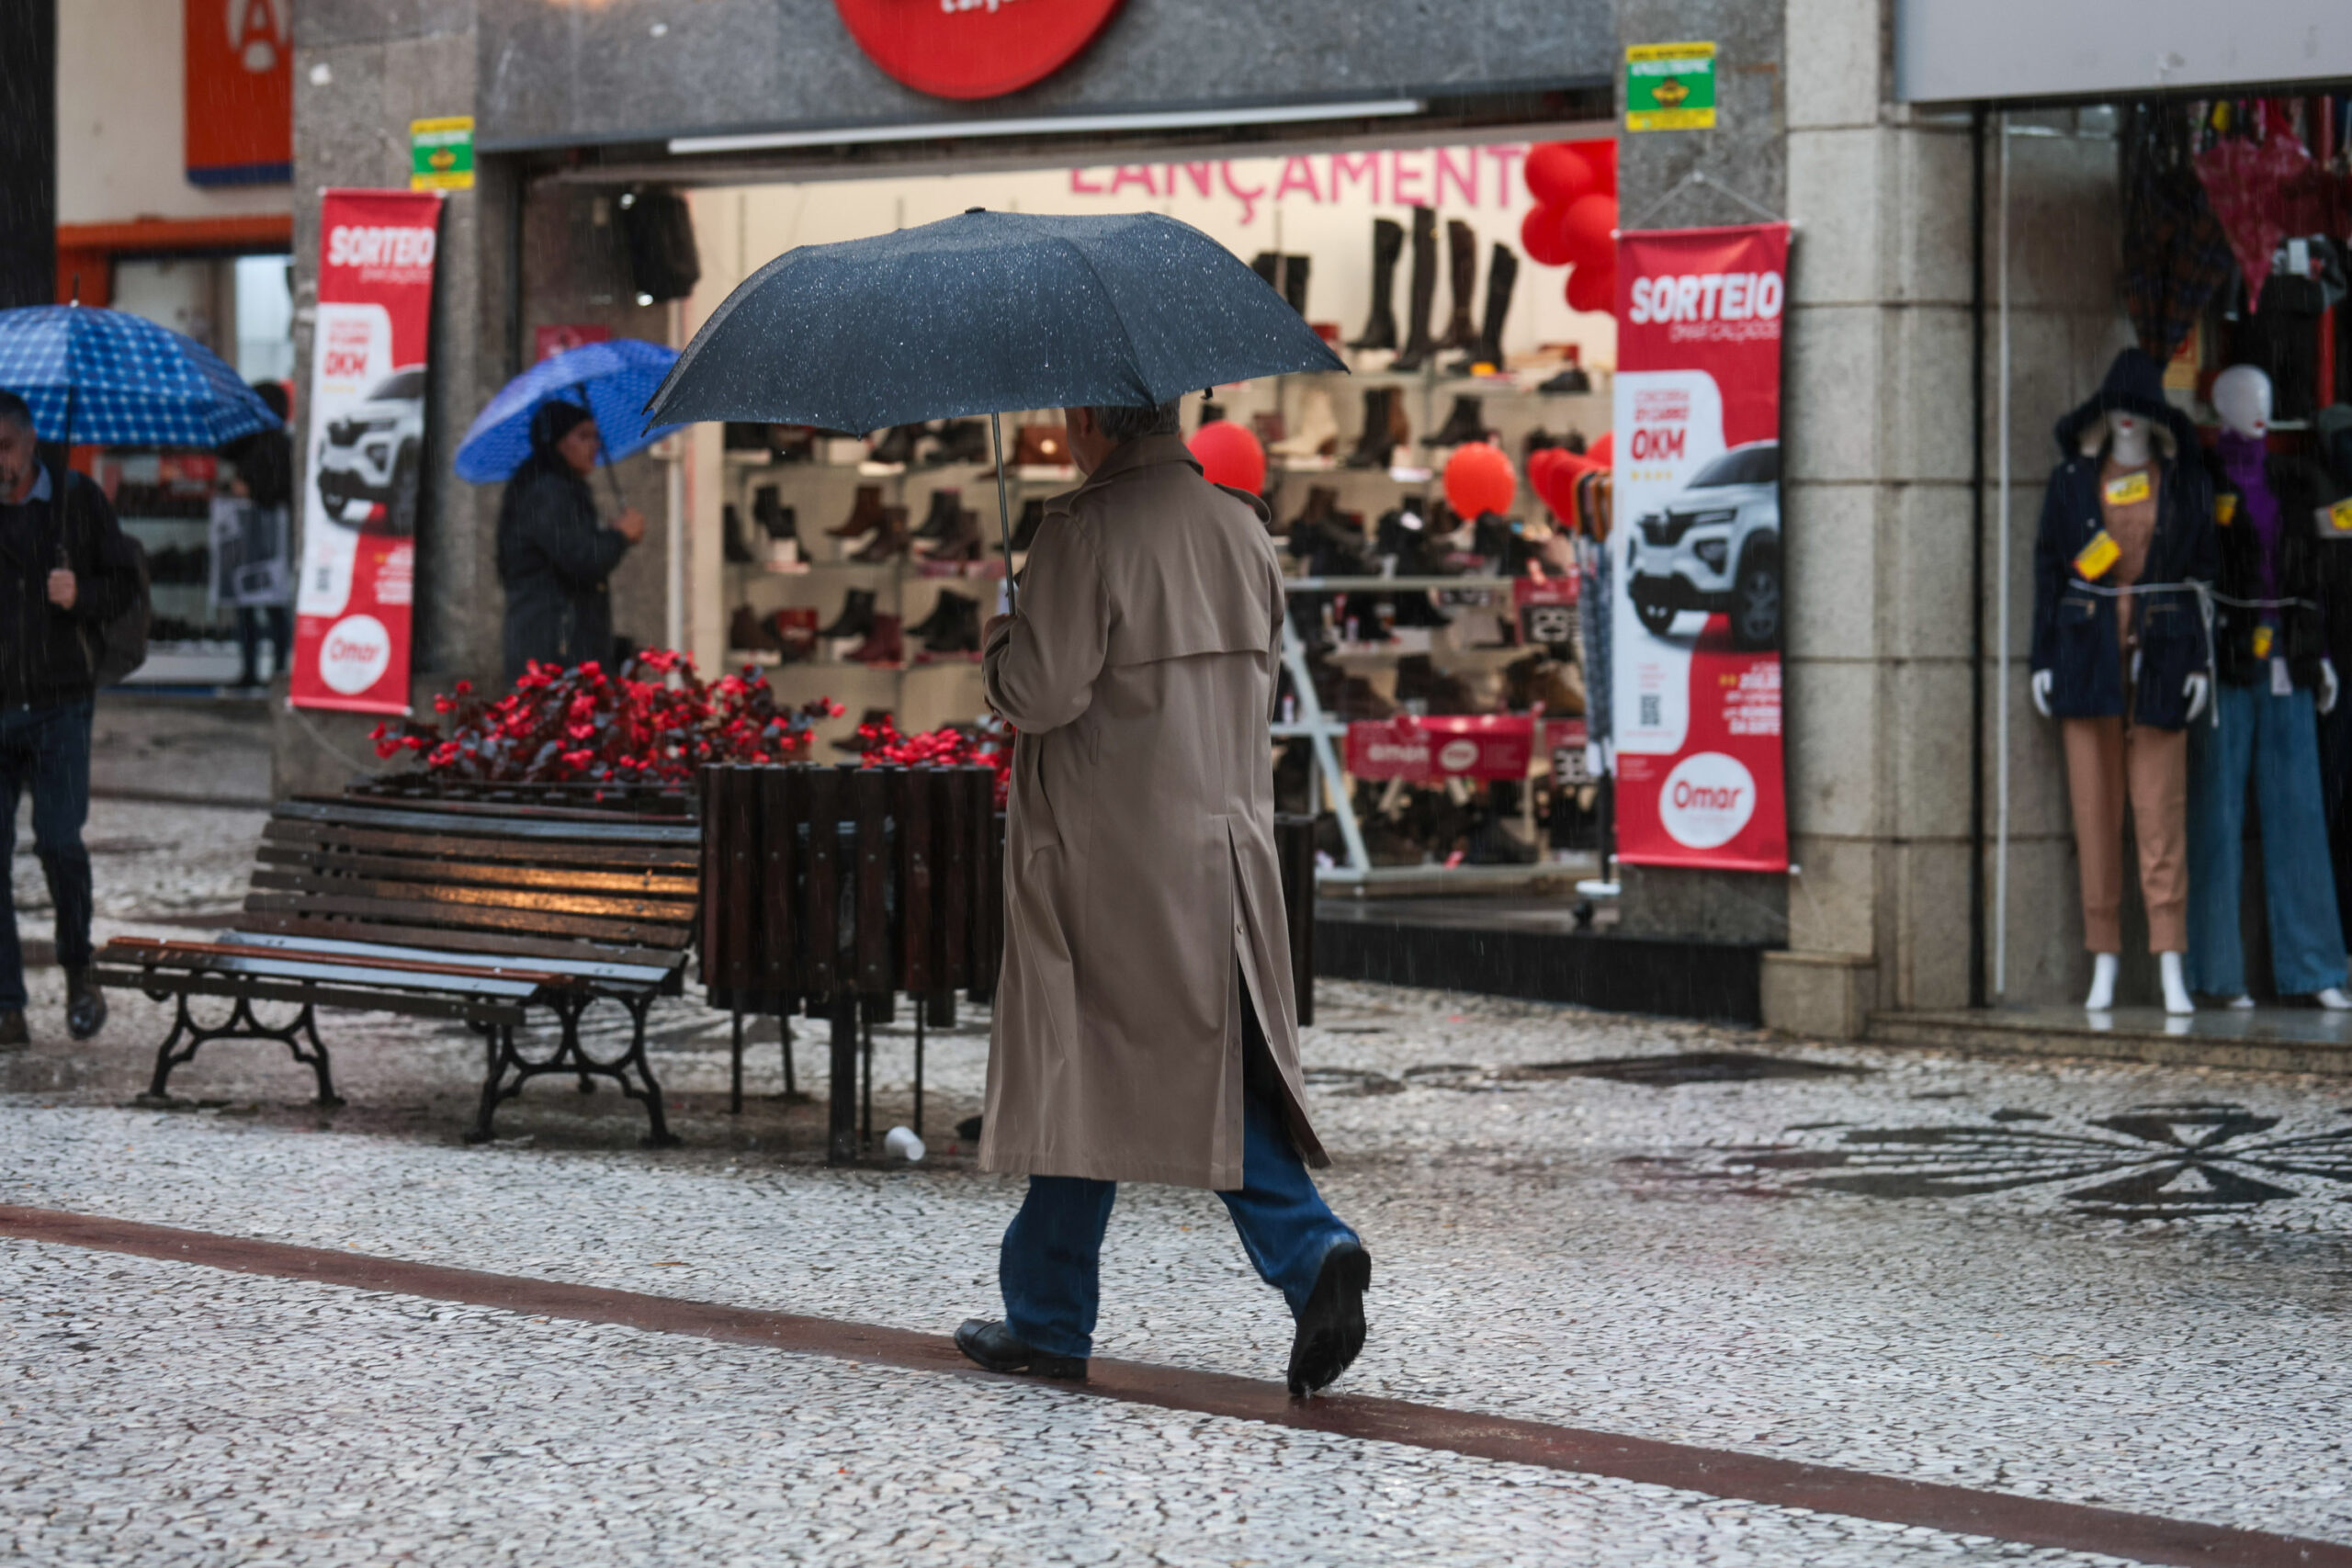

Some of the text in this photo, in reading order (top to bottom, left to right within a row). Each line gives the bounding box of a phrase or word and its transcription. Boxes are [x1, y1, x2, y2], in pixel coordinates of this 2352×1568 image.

[1069, 144, 1527, 225] LANÇAMENT
[328, 225, 435, 267] SORTEIO
[1628, 271, 1784, 324] SORTEIO
[1673, 780, 1743, 809] Omar
